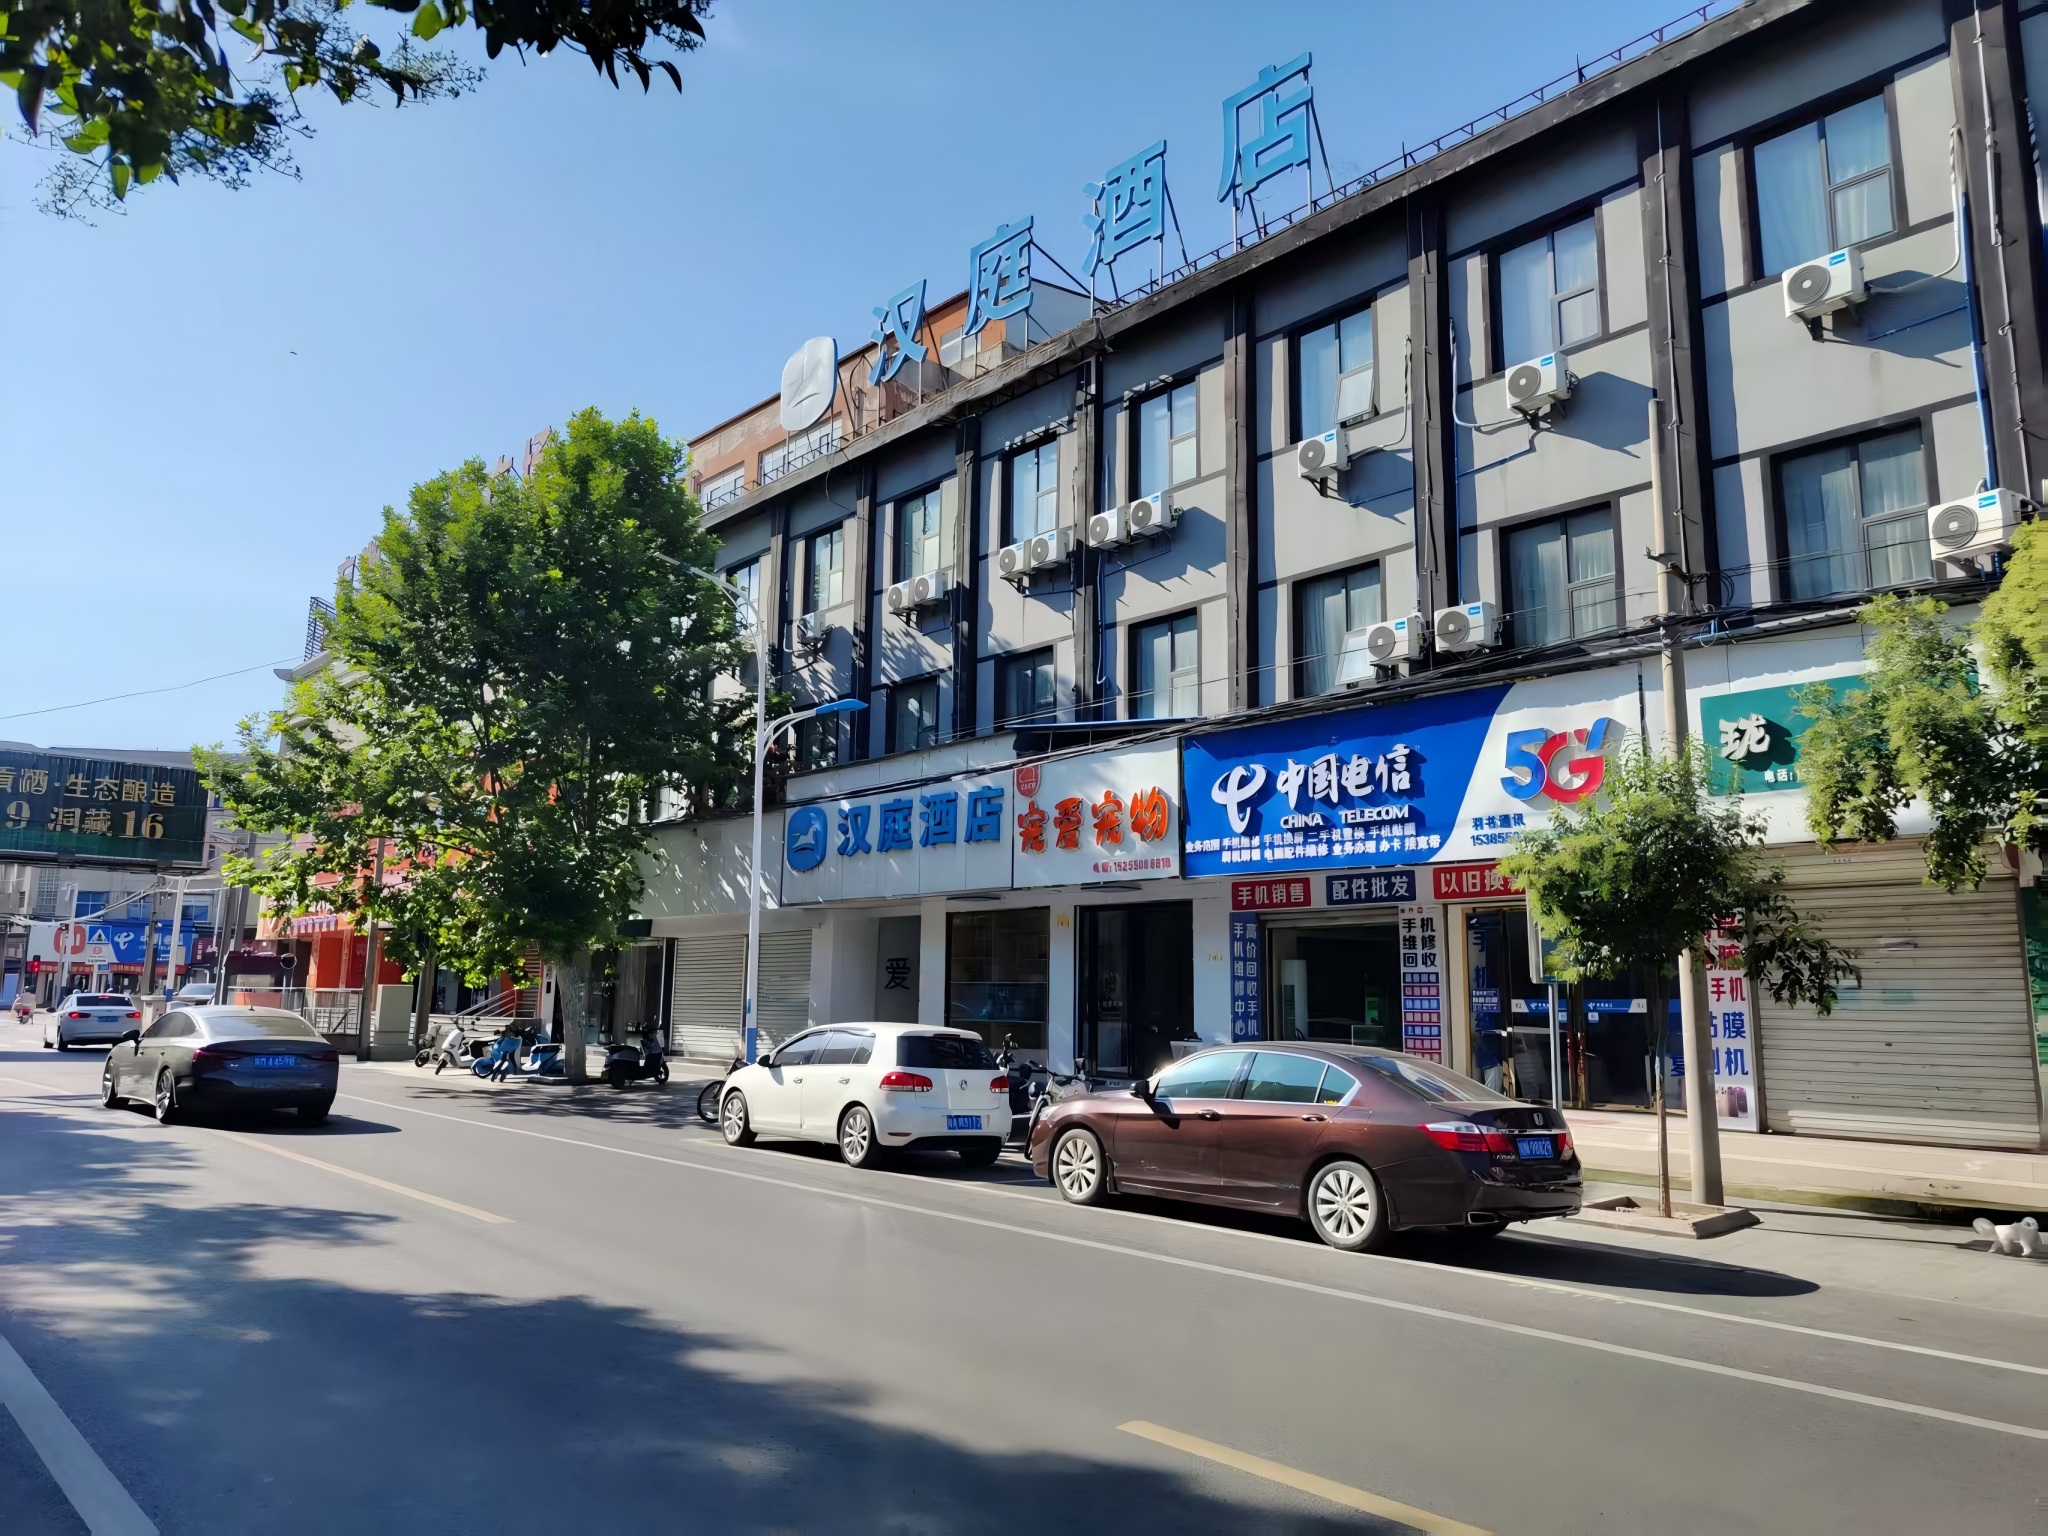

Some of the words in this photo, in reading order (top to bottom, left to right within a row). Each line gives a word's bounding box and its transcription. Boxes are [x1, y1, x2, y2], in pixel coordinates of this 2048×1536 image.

[867, 51, 1314, 388] 汉庭酒店
[1276, 743, 1411, 809] 中国电信
[1501, 727, 1605, 804] 5G
[836, 785, 1005, 858] 汉庭酒店
[1279, 811, 1324, 829] CHINA
[1338, 804, 1410, 825] TELECOM
[1237, 883, 1305, 906] 手机销售
[1332, 875, 1410, 901] 配件批发
[1402, 917, 1436, 934] 手机
[1402, 934, 1437, 951] 维修
[884, 957, 911, 990] 爱
[1402, 952, 1438, 969] 回收
[1710, 976, 1746, 1003] 手机
